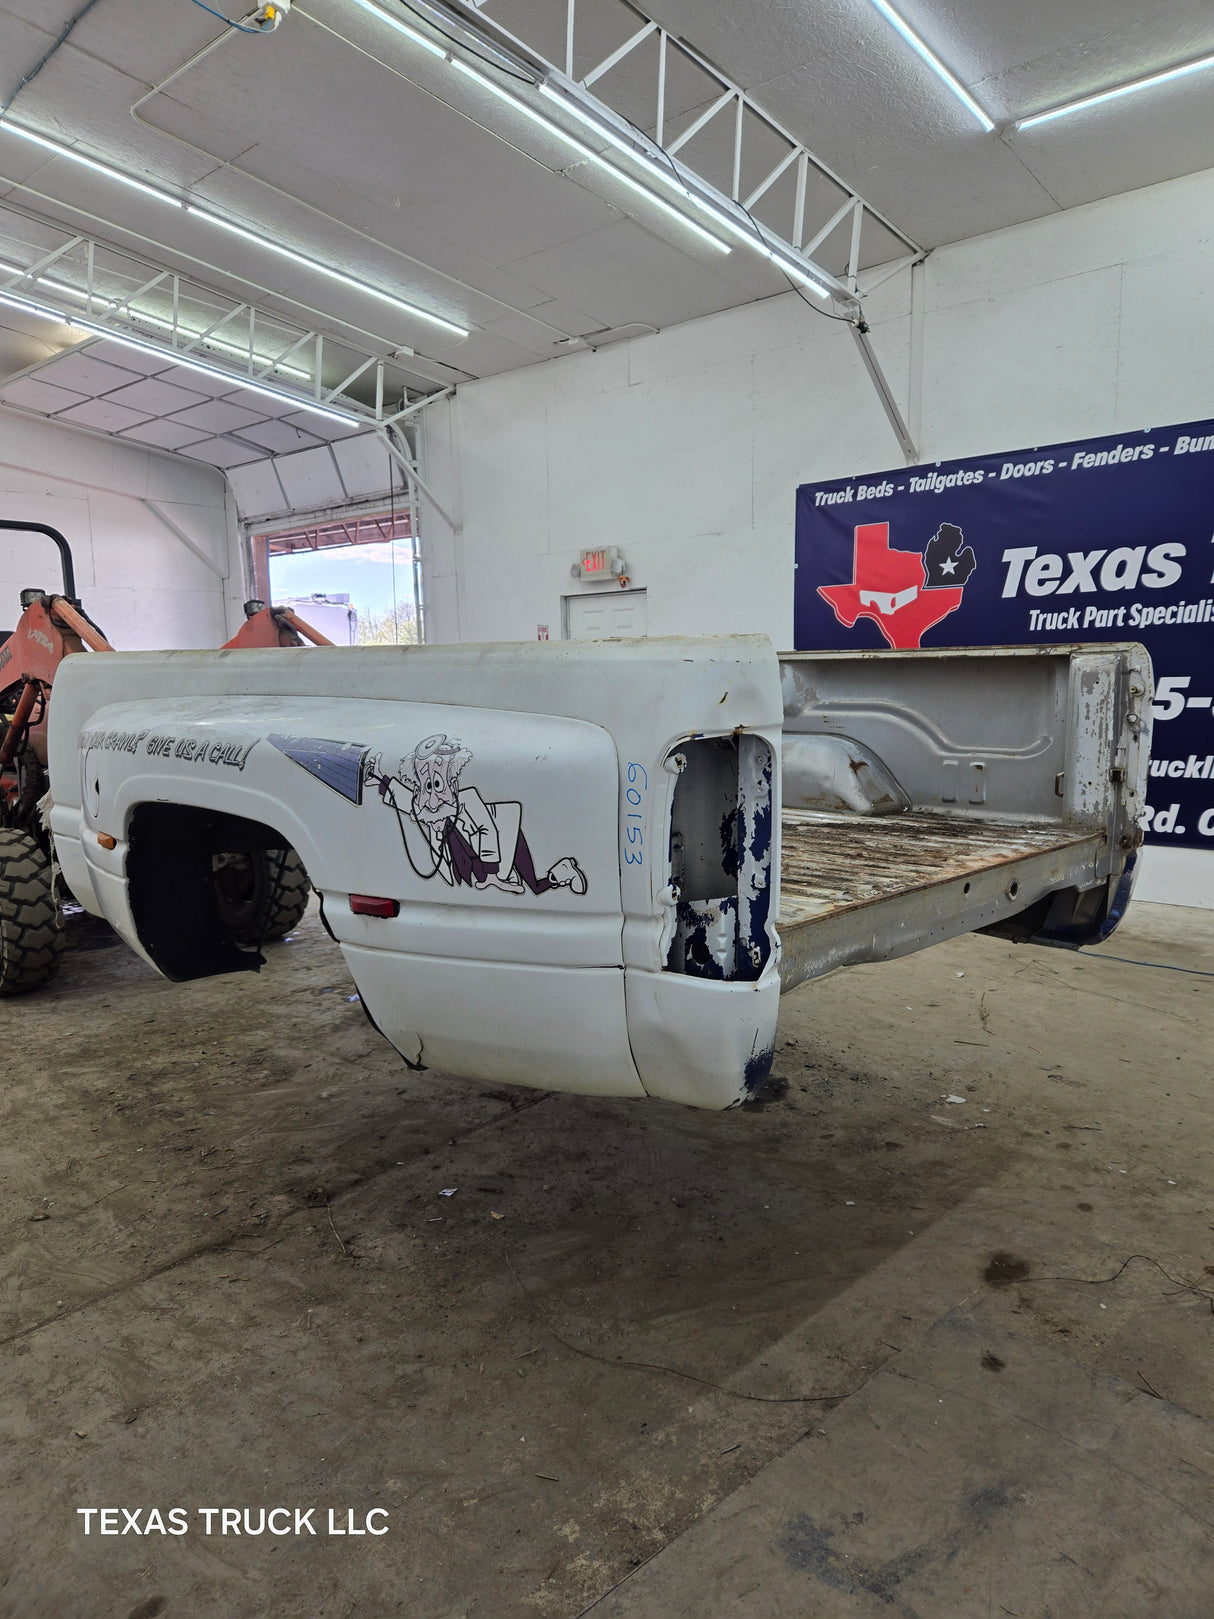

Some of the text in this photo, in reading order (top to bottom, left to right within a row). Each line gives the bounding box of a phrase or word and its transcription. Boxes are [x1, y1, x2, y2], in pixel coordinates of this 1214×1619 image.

[815, 487, 855, 507] Truck
[857, 480, 895, 501] Beds
[909, 469, 985, 494] Tailgates
[1000, 459, 1055, 480] Doors
[1071, 443, 1155, 470] Fenders
[585, 550, 606, 572] EXIT
[1001, 542, 1187, 598] Texas
[1029, 608, 1081, 631] Truck
[1082, 606, 1127, 629] Part
[1152, 676, 1214, 721] 5-
[146, 736, 175, 758] GIVE
[175, 738, 197, 761] US
[209, 738, 261, 772] CALL!
[1149, 754, 1214, 779] uckl
[624, 761, 648, 865] 60153
